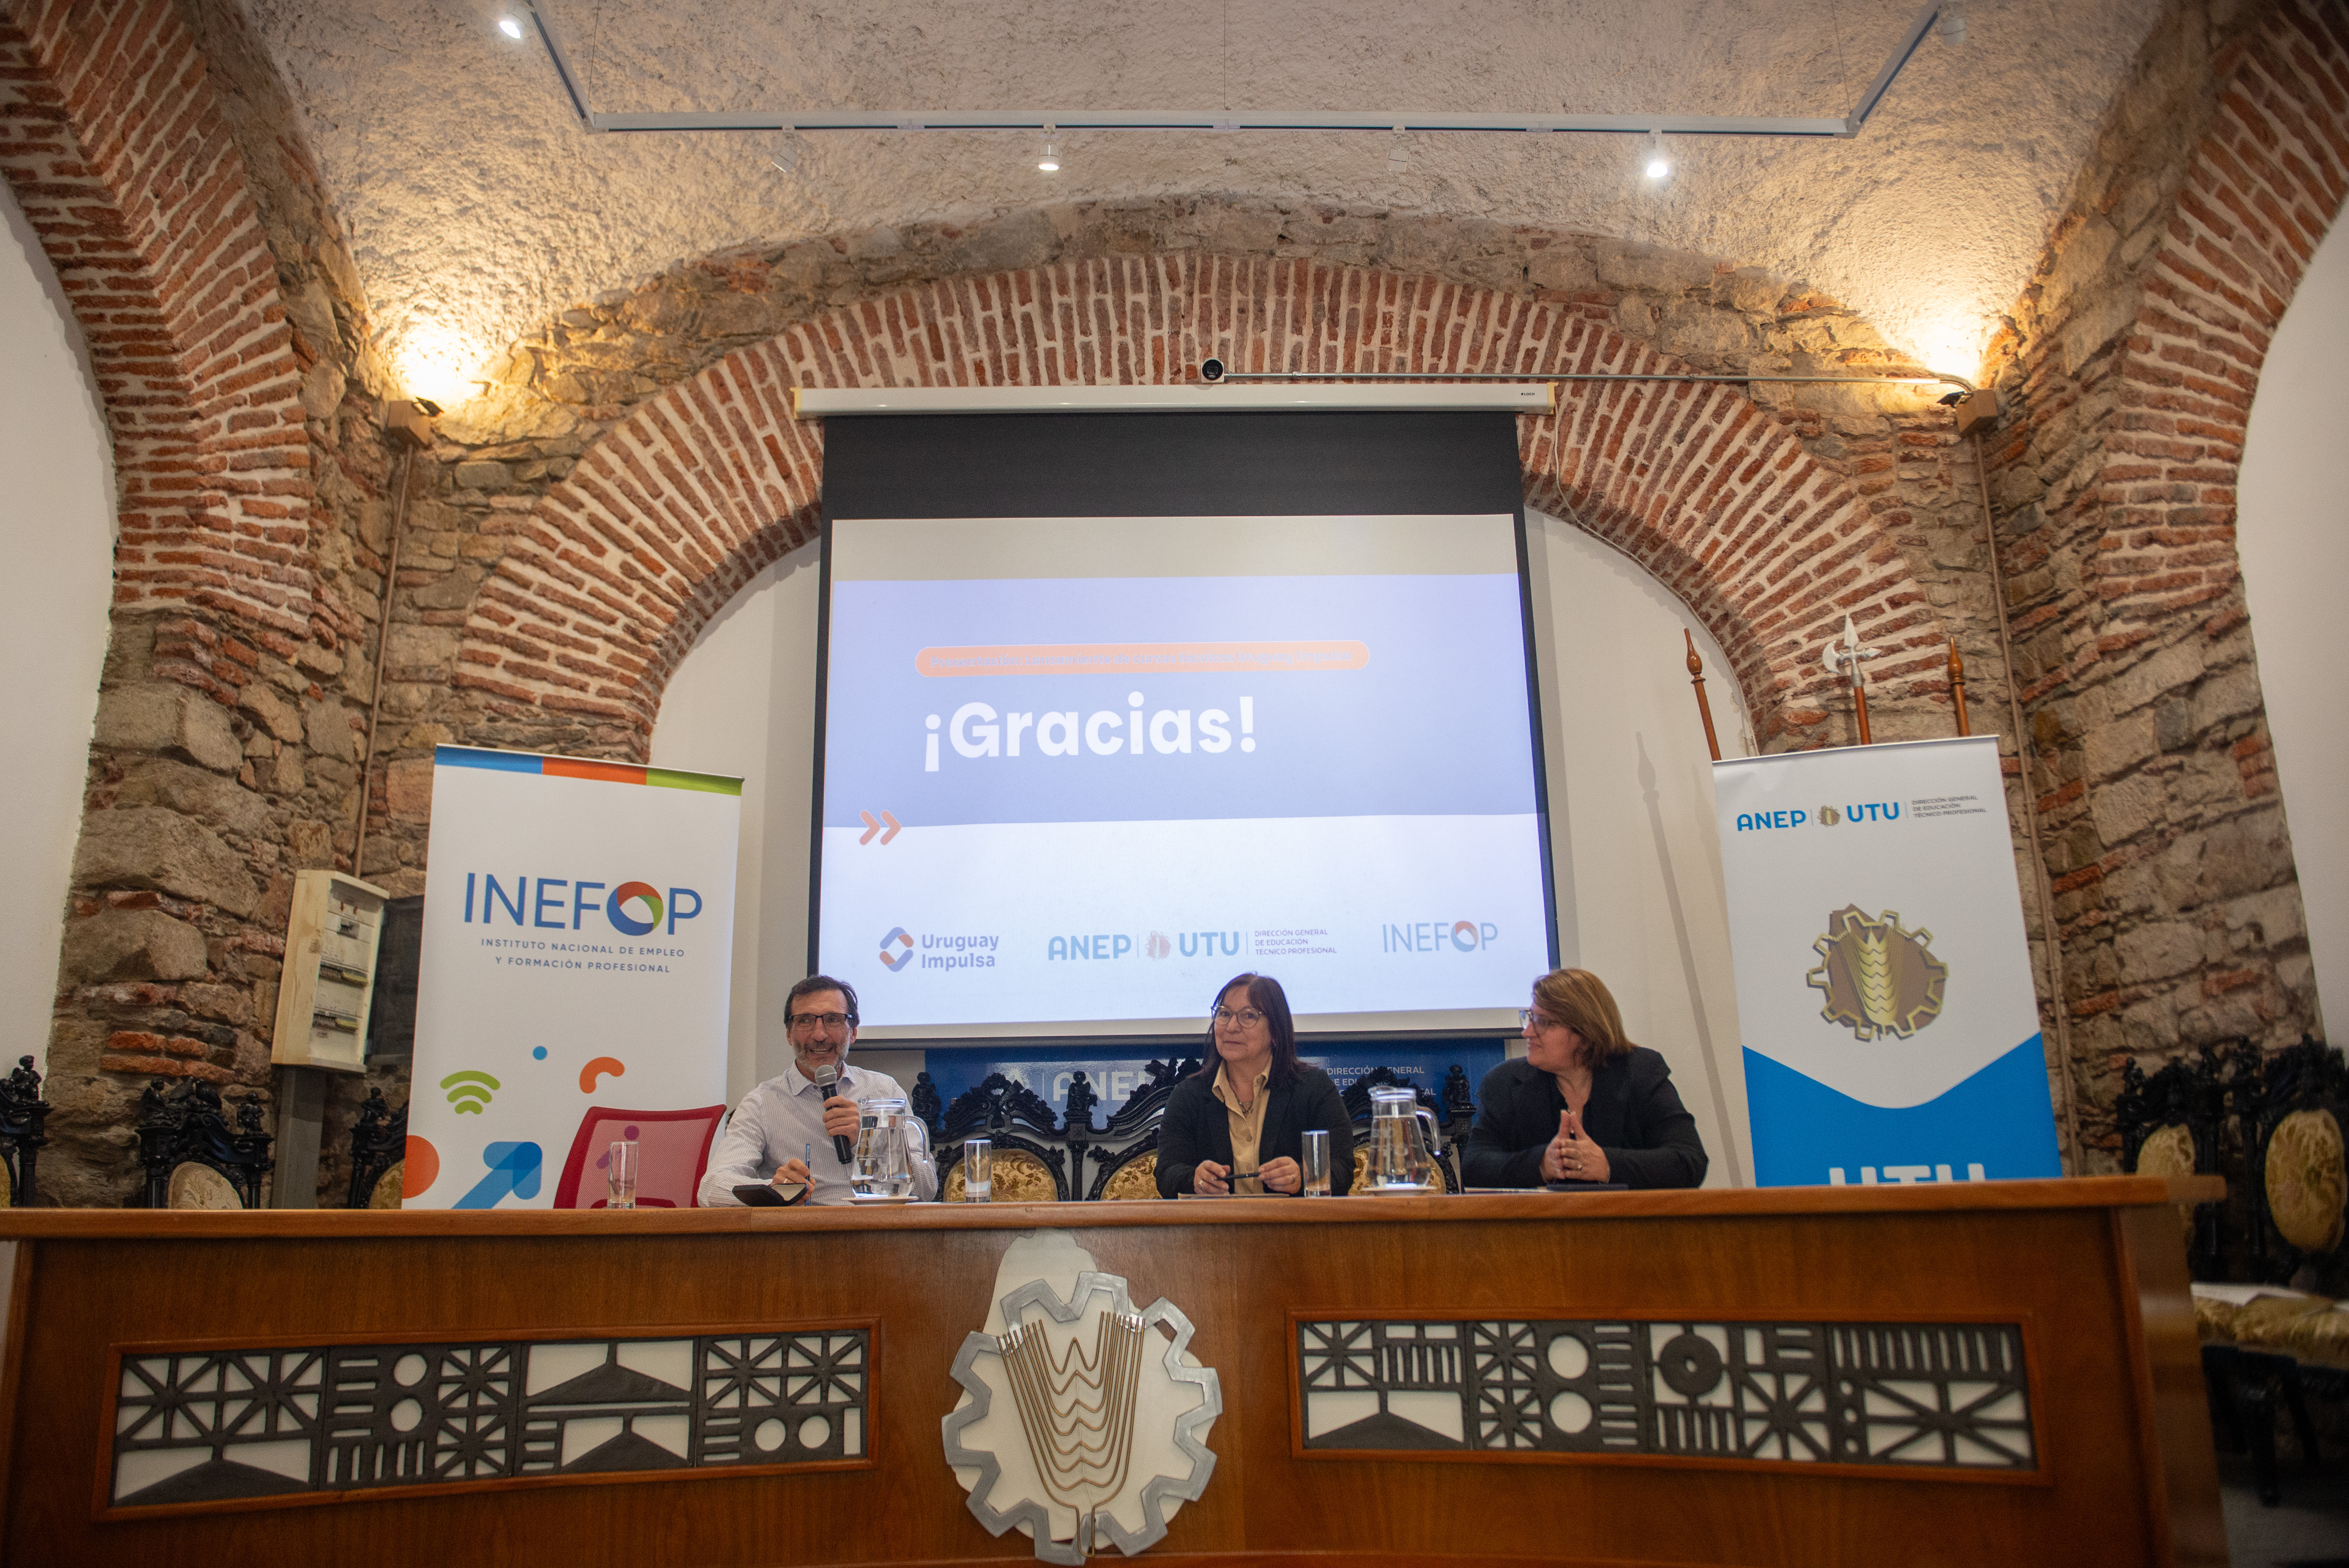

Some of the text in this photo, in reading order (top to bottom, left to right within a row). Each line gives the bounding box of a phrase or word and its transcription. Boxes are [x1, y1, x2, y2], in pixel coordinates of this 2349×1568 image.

[931, 650, 1352, 668] Presentación: Lanzamiento de cursos técnicos Uruguay Impulsa
[925, 691, 1256, 772] ¡Gracias!
[1737, 802, 1899, 831] ANEP UTU
[464, 872, 703, 936] INEFOP
[922, 933, 999, 952] Uruguay
[1048, 931, 1239, 961] ANEP UTU
[1266, 937, 1308, 946] EDUCACIÓN
[1383, 920, 1498, 952] INEFOP
[481, 938, 546, 950] INSTITUTO
[551, 943, 614, 954] NACIONAL
[639, 947, 685, 958] EMPLEO
[508, 957, 582, 969] FORMACIÓN
[588, 962, 670, 973] PROFESIONAL
[922, 952, 995, 972] Impulsa
